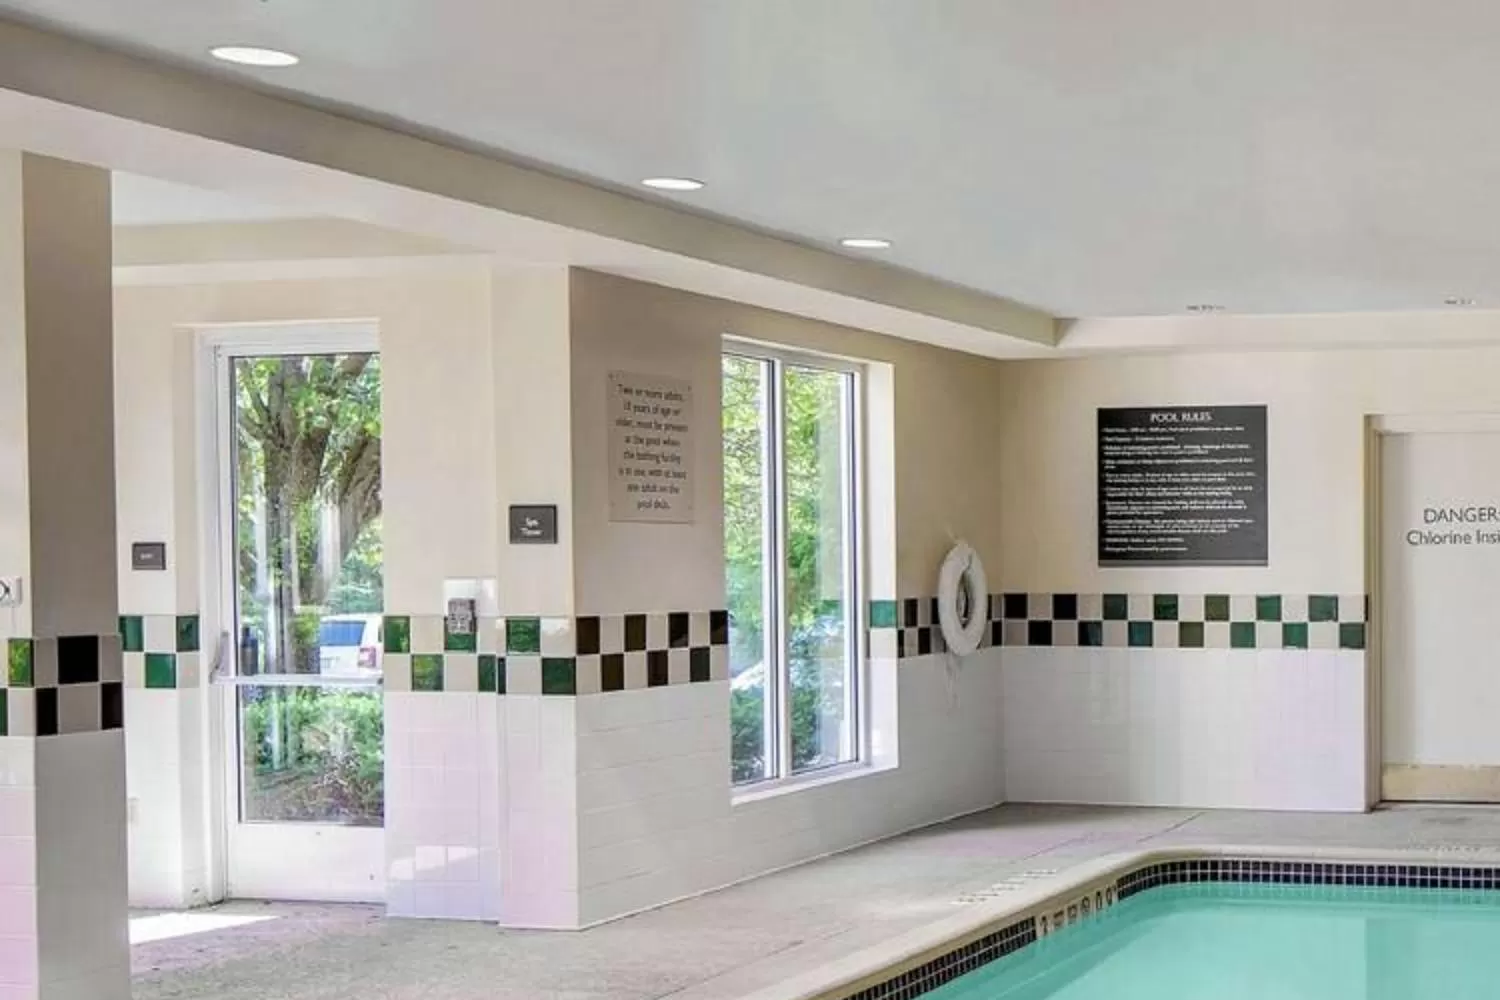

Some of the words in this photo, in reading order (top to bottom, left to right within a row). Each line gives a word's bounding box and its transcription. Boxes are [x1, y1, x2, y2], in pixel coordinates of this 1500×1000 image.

[1150, 412, 1179, 422] POOL
[1181, 411, 1213, 422] RULES
[1406, 529, 1472, 545] Chlorine
